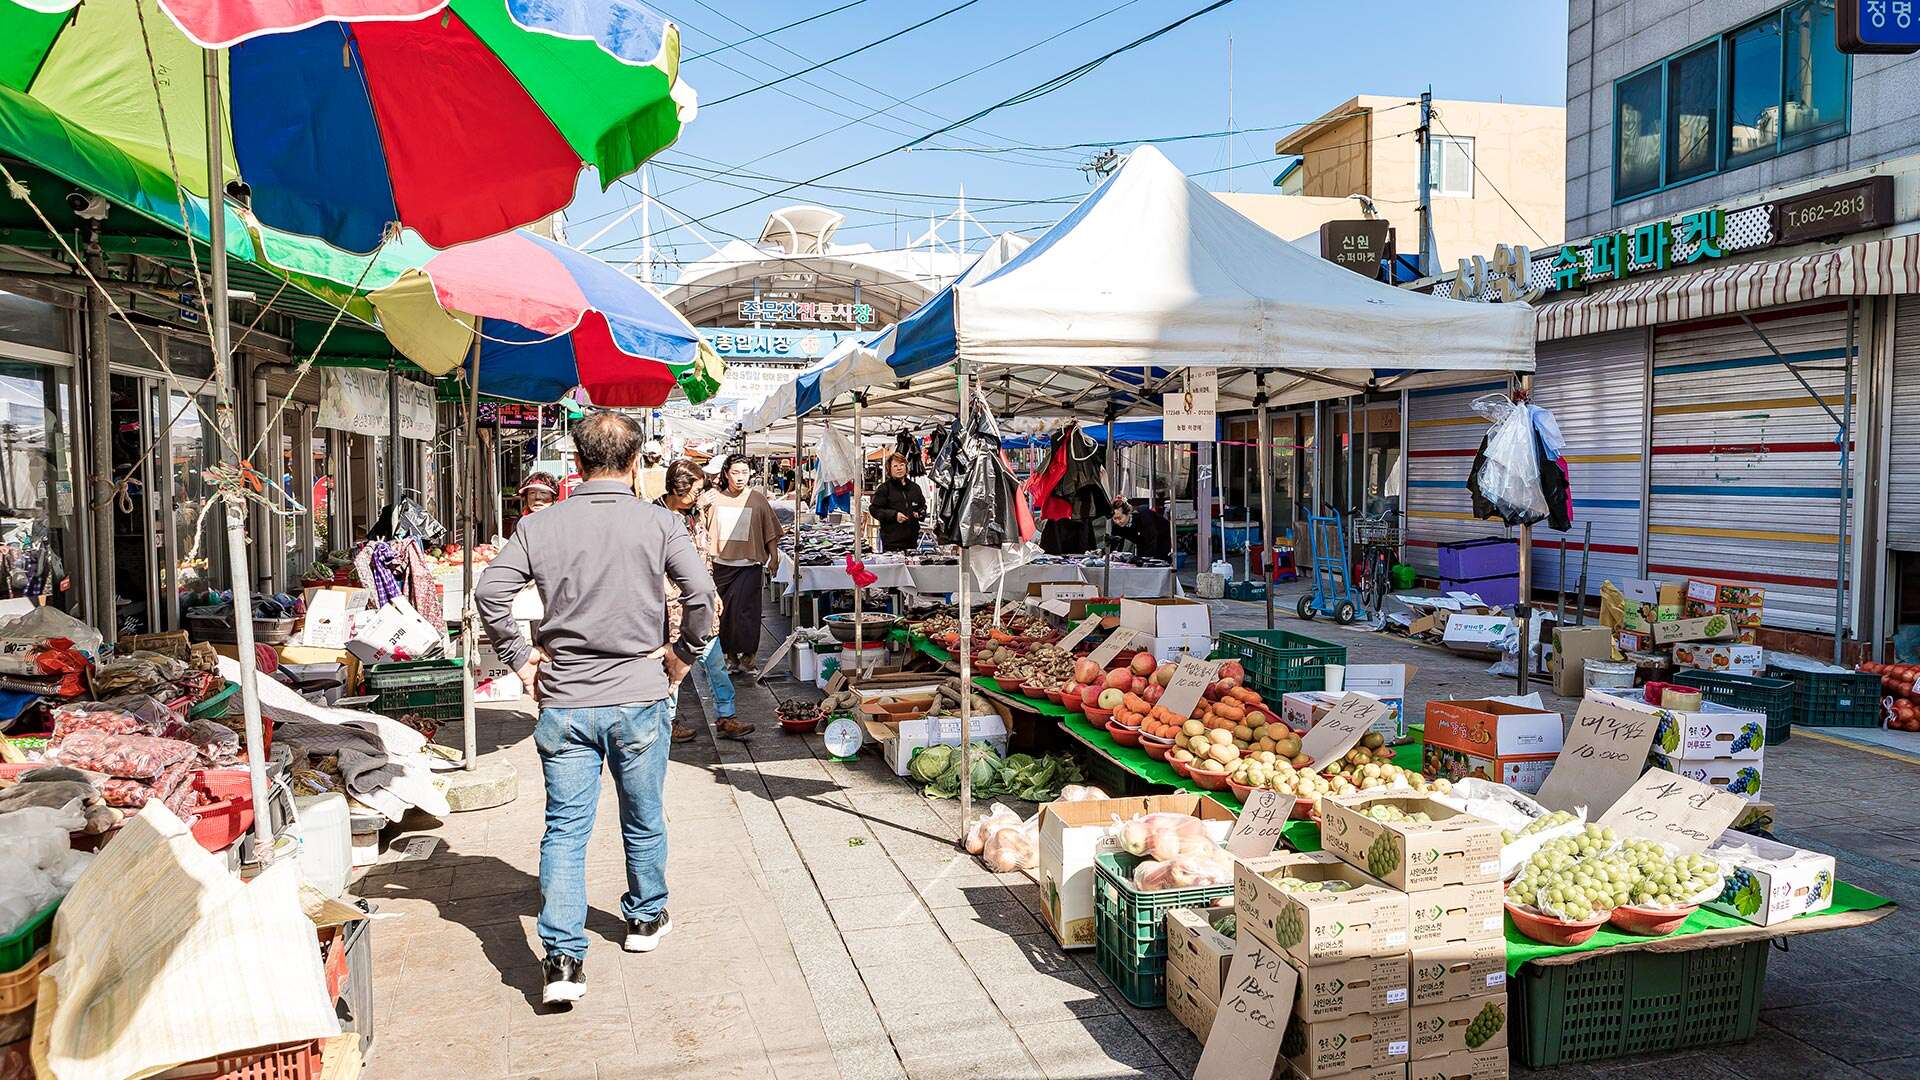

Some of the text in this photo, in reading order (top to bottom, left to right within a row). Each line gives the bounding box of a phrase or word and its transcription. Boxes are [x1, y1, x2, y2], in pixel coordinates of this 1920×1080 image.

[1867, 1, 1920, 28] 정명
[1789, 196, 1864, 226] T.662-2813
[1342, 235, 1369, 250] 신원
[1551, 209, 1726, 291] 슈퍼마켓
[1337, 252, 1376, 263] 슈퍼마켓
[714, 334, 791, 355] 종합시장
[389, 628, 407, 646] 고구마
[489, 669, 508, 677] 고구마
